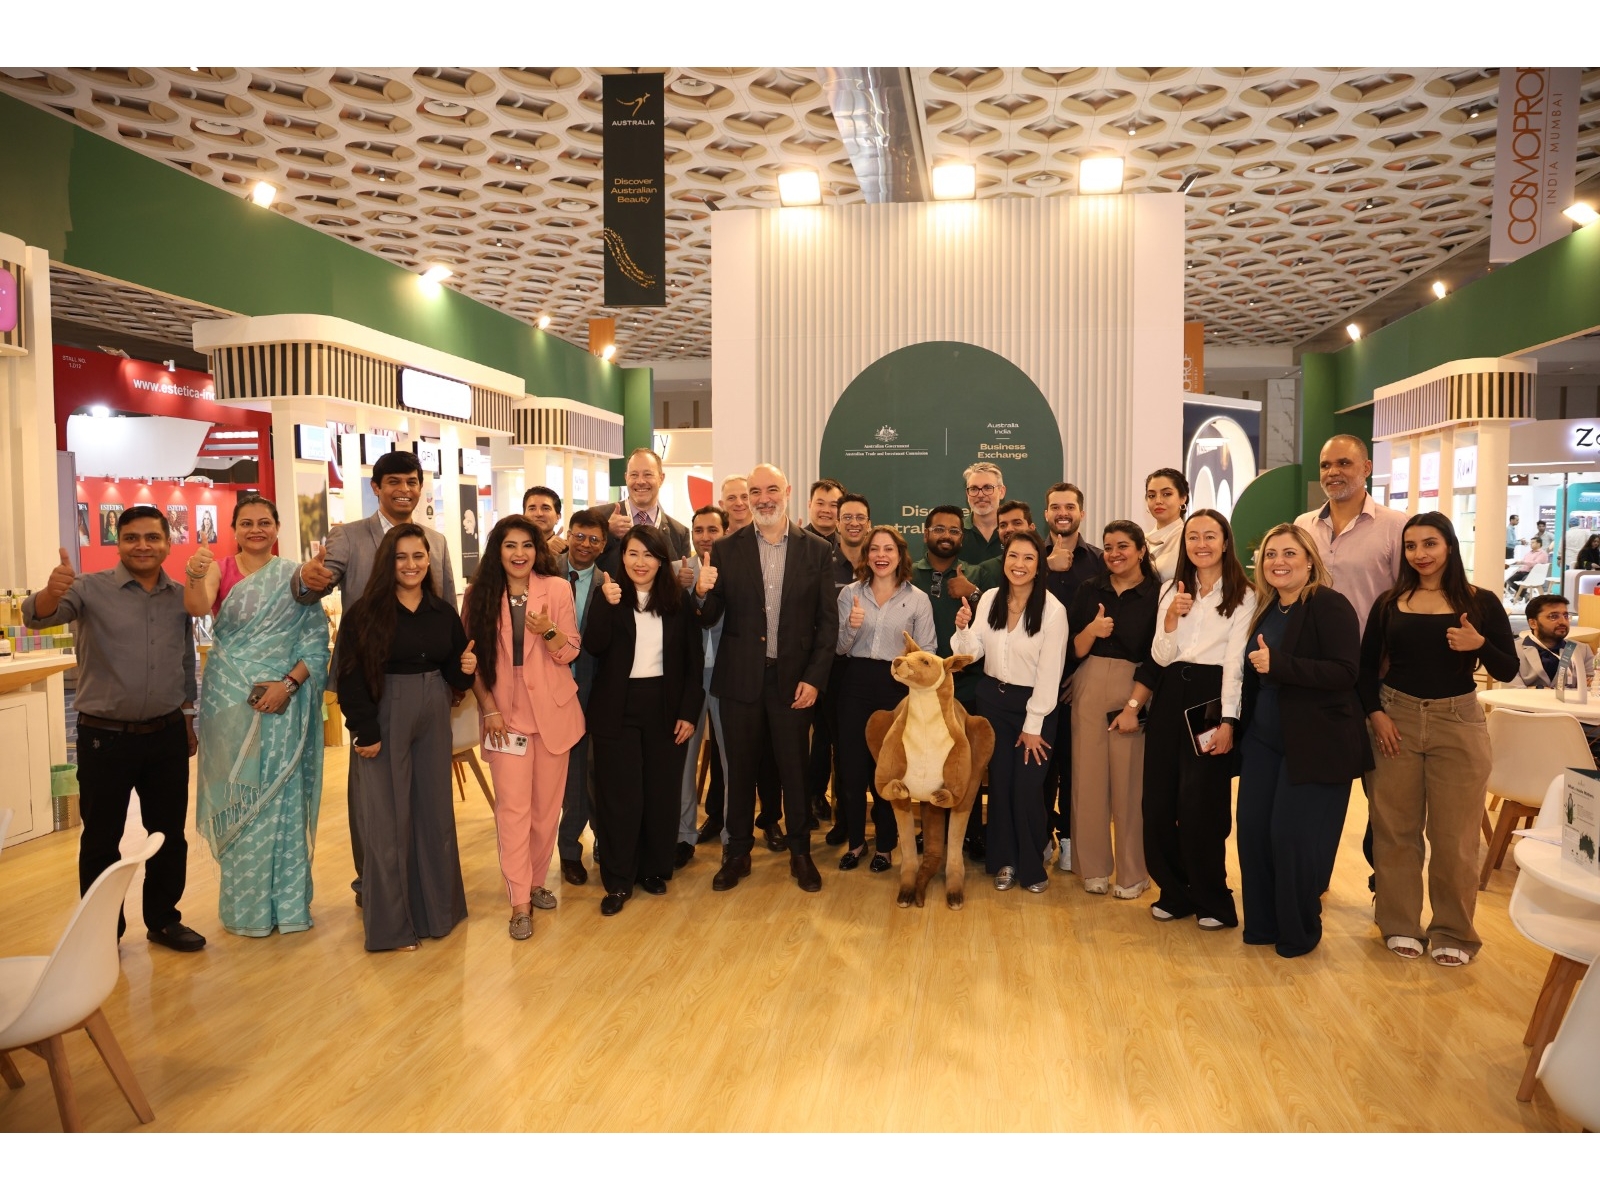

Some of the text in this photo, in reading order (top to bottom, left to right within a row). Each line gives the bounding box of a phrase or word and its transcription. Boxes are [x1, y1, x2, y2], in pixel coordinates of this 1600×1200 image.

[1547, 93, 1563, 205] INDIA MUMBAI
[977, 451, 1028, 460] Exchange
